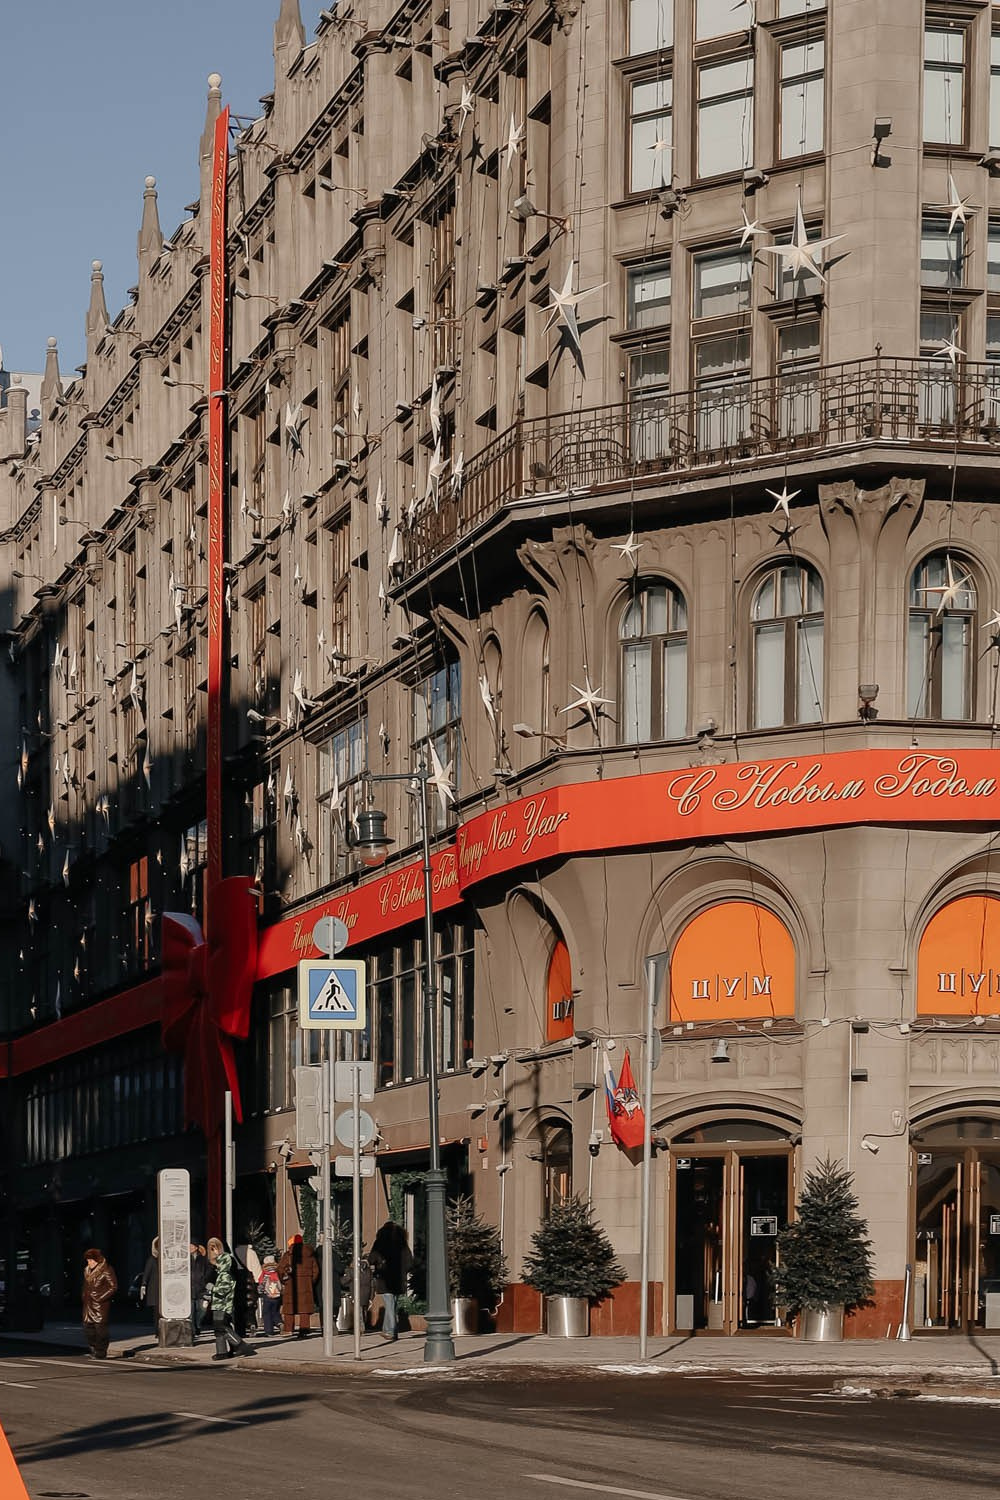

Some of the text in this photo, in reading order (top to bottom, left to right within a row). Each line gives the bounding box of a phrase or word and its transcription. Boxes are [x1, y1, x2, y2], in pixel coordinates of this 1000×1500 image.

[209, 435, 220, 640] Happy New Year
[667, 753, 998, 817] С Новым Годом
[459, 797, 569, 877] Happy New Year
[937, 970, 1000, 996] ЦУ
